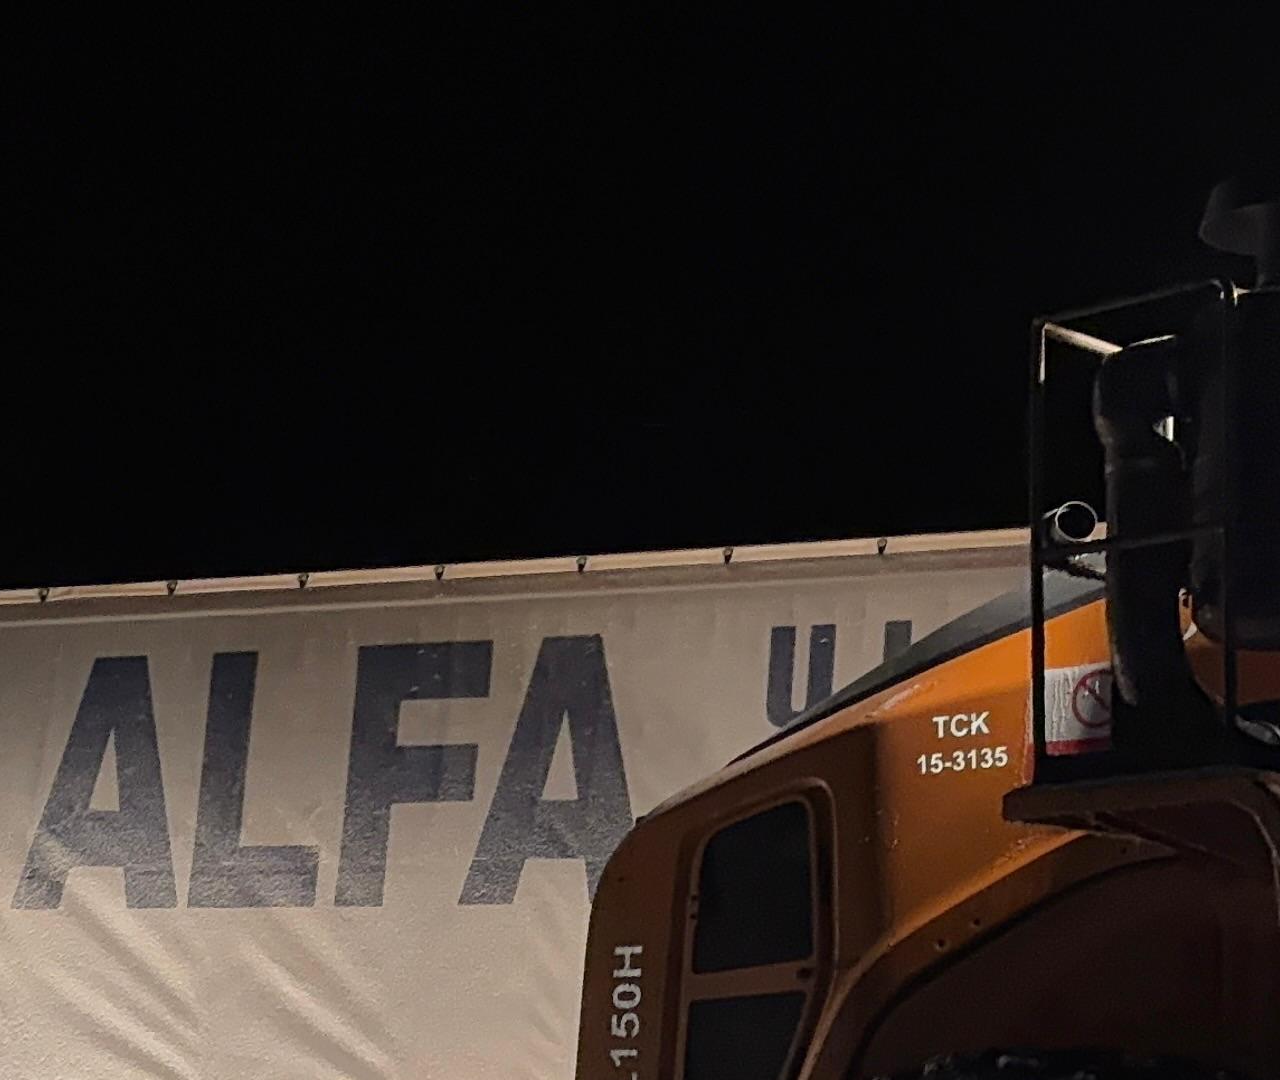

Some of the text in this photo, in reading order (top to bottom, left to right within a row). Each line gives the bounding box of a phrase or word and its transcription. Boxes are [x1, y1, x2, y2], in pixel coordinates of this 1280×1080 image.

[932, 711, 990, 738] TCK
[11, 634, 635, 909] ALFA
[917, 746, 1008, 775] 15-3135
